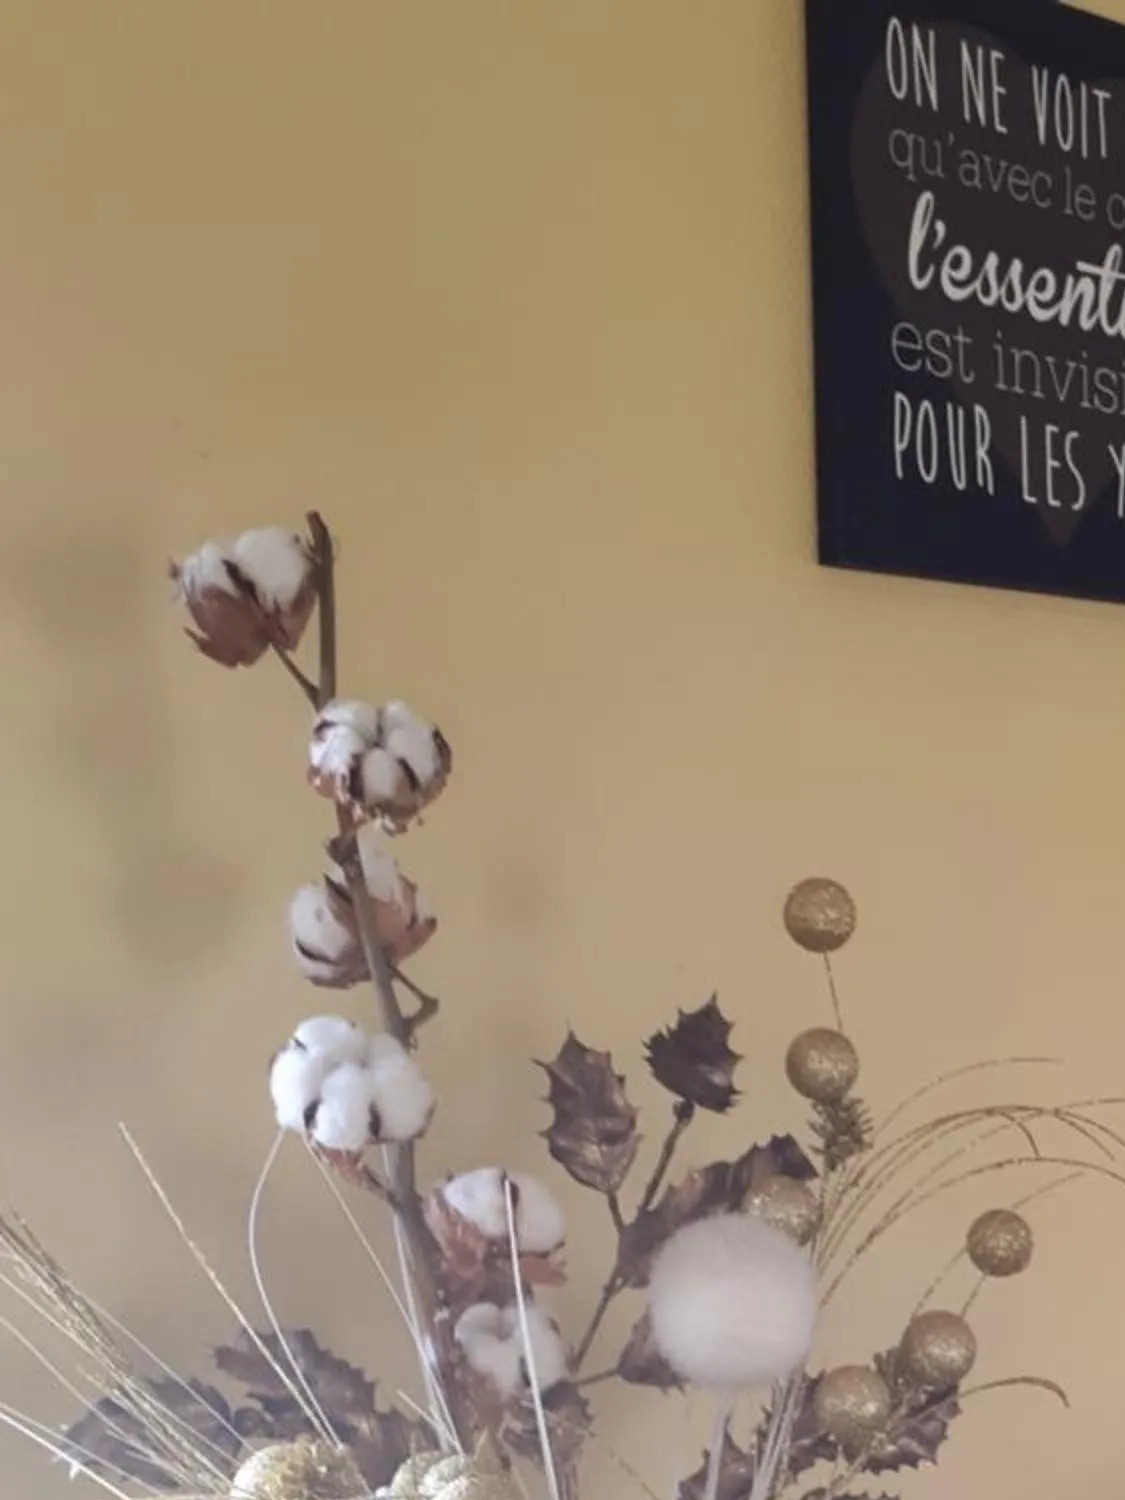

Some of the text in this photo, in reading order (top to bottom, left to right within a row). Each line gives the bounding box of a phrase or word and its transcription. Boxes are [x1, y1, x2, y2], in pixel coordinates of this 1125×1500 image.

[886, 16, 939, 112] ON
[960, 39, 1008, 135] NE
[1031, 65, 1112, 161] VOIT
[1064, 167, 1096, 222] le
[891, 321, 975, 386] est
[894, 391, 995, 497] POUR
[1020, 415, 1086, 511] LES
